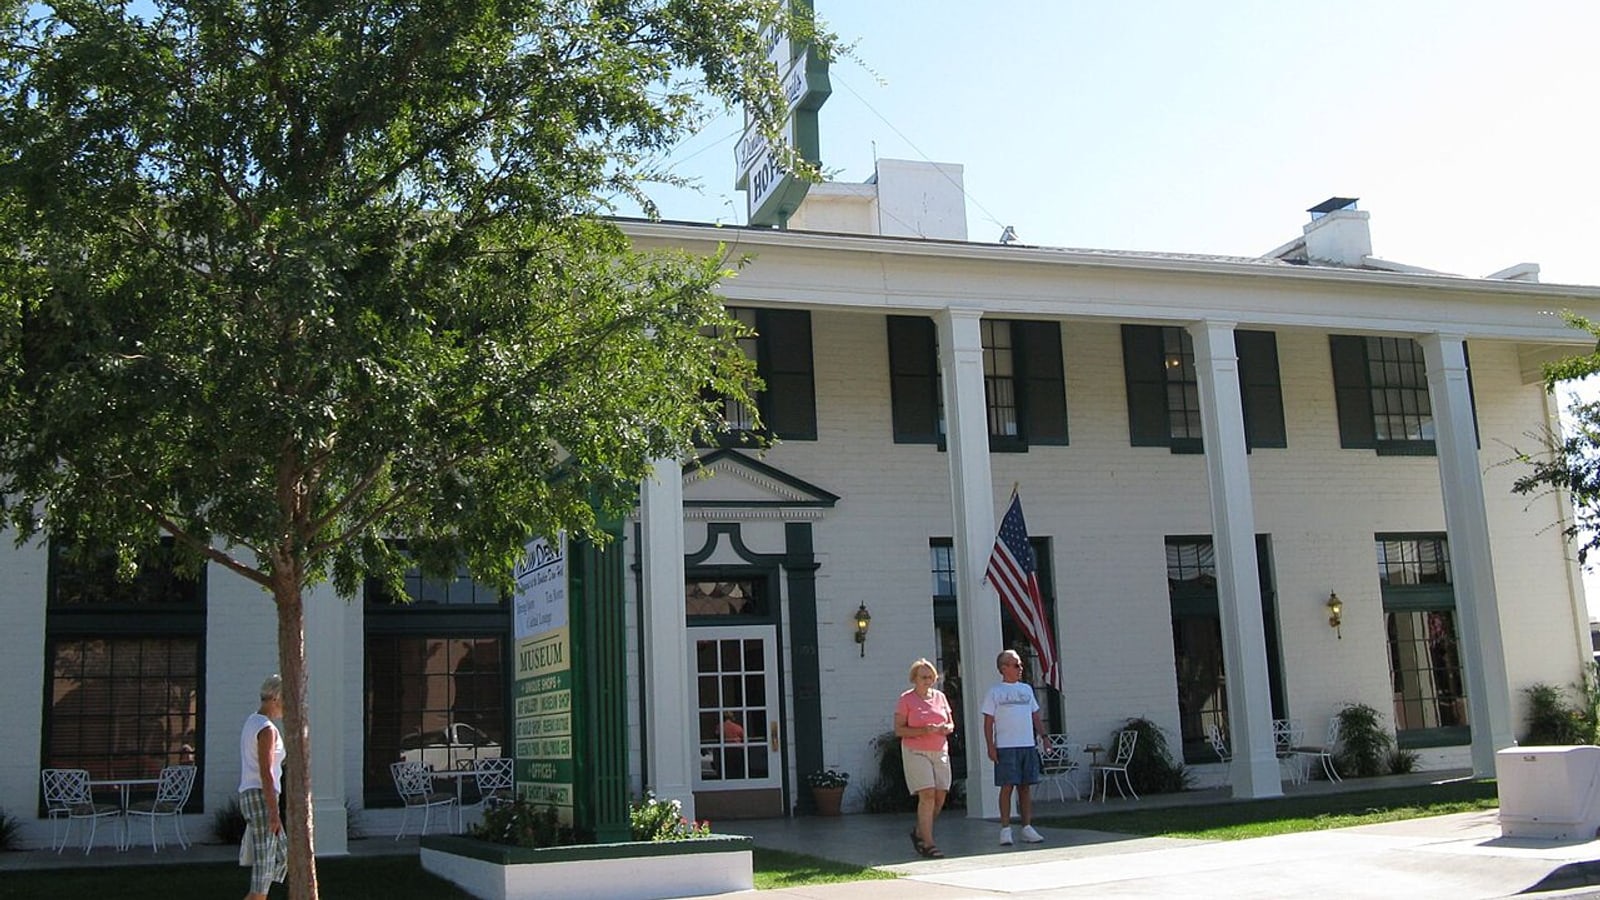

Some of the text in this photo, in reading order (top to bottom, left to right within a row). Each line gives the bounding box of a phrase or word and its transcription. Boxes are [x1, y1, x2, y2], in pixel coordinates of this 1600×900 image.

[520, 642, 562, 673] MUSEUM
[541, 676, 557, 690] SHOPS
[532, 763, 552, 779] OFFICES
